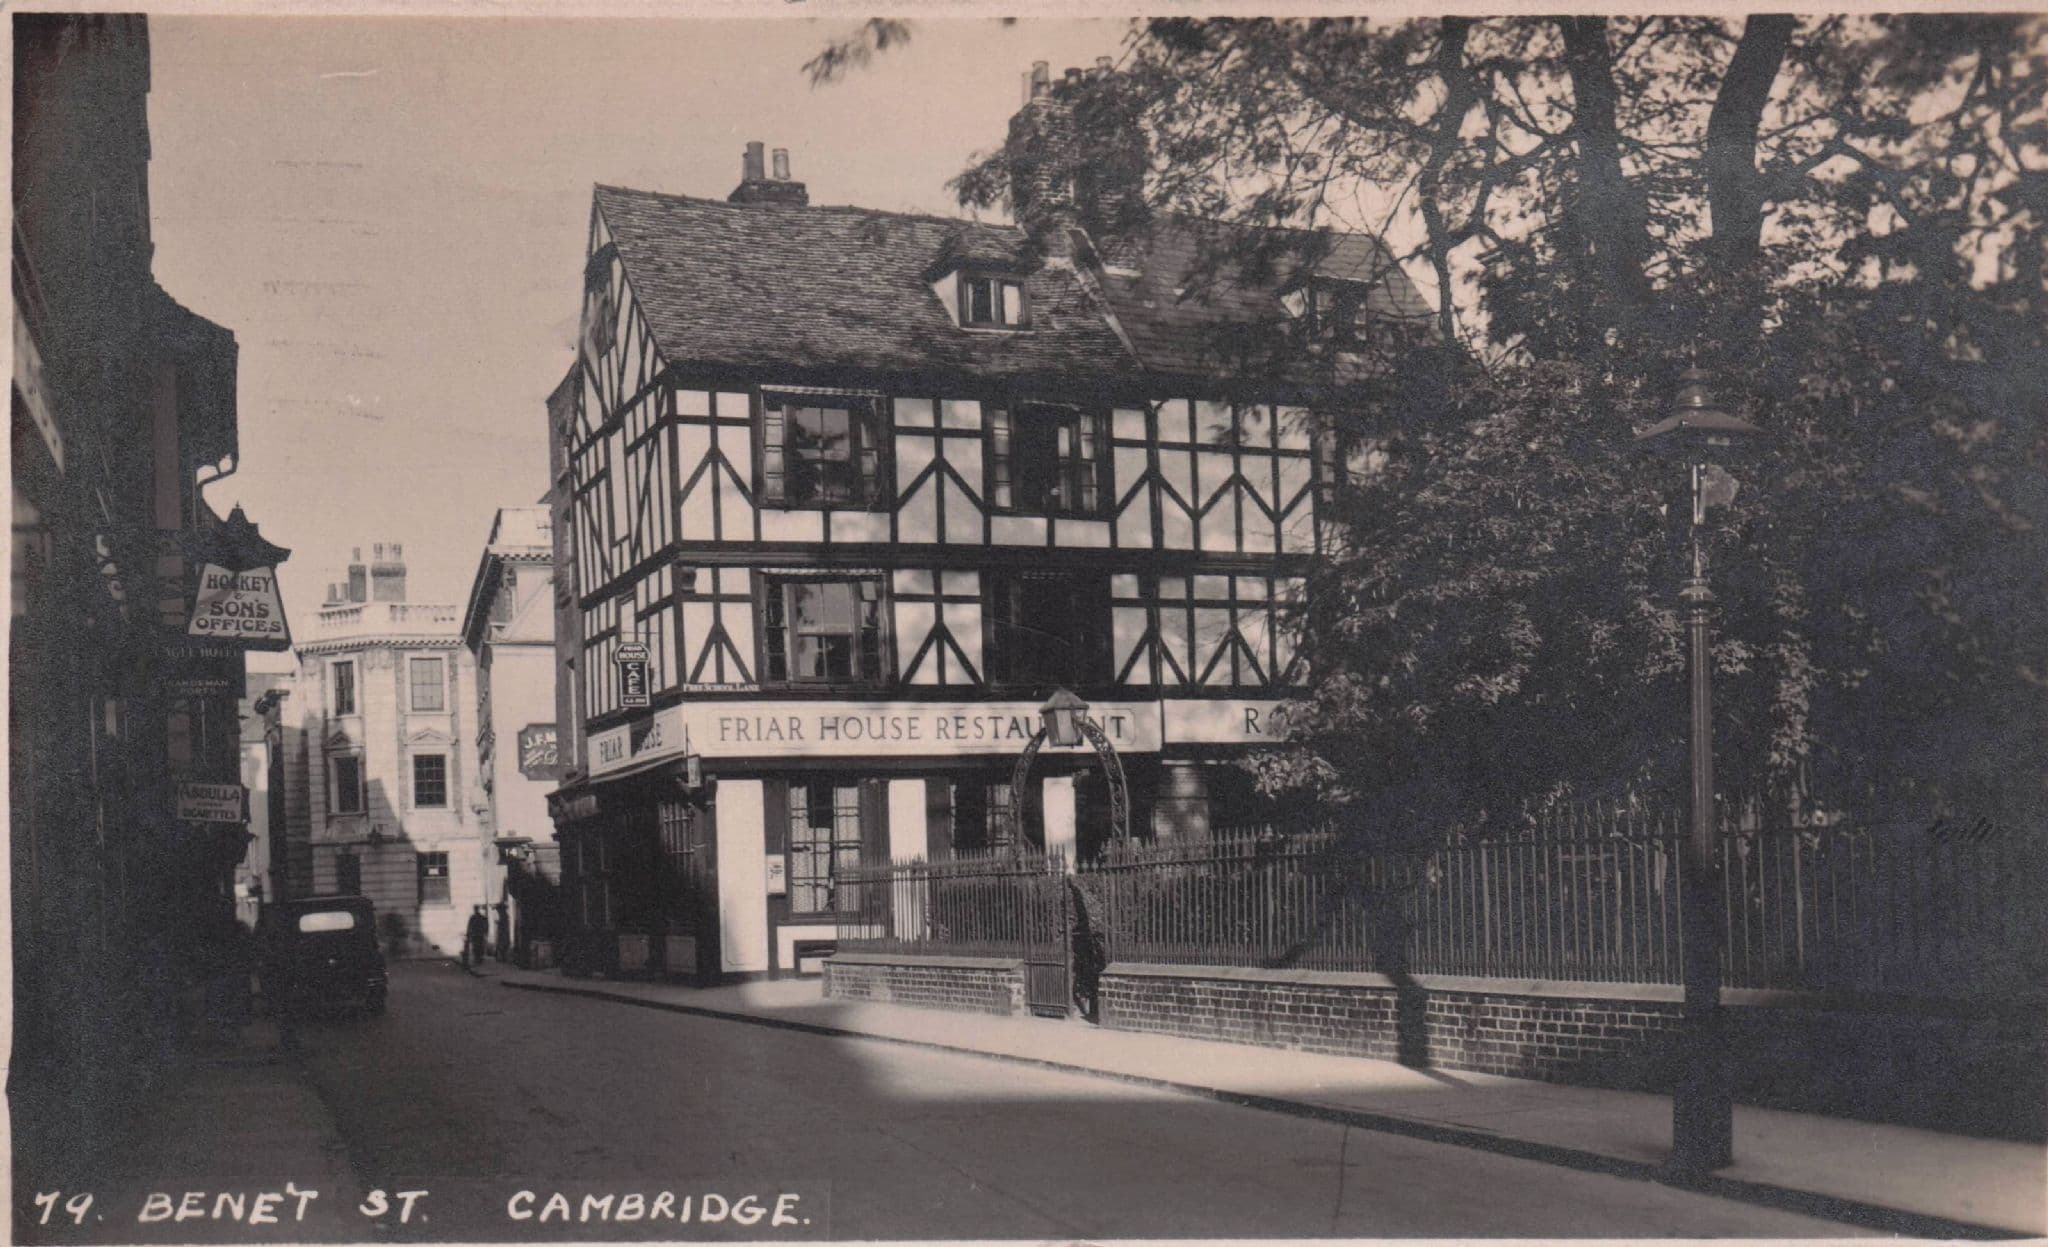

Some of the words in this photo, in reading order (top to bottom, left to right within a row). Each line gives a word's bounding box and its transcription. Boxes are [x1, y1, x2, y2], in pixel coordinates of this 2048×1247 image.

[195, 617, 283, 633] OFFICES
[718, 716, 804, 742] FRIAR
[819, 716, 921, 741] HOUSE
